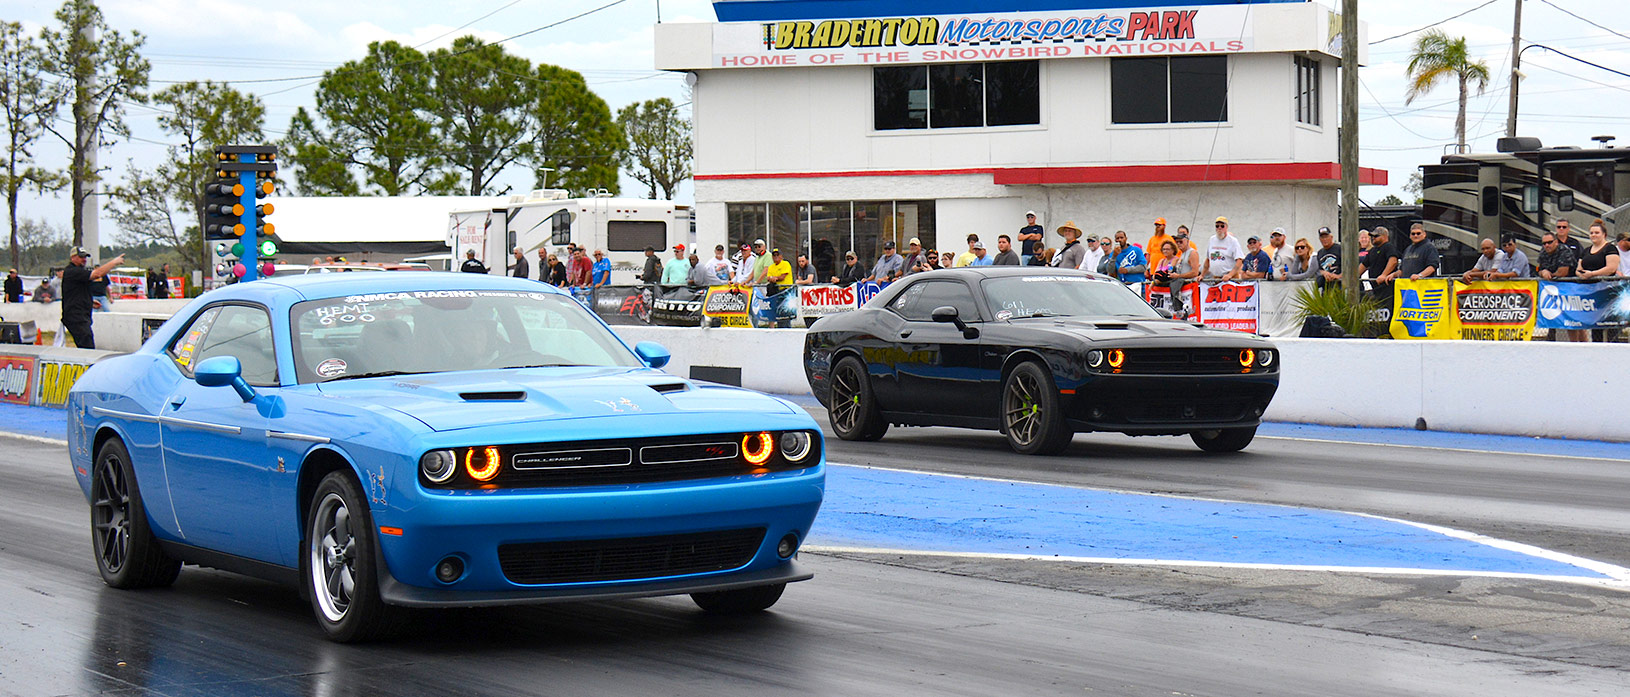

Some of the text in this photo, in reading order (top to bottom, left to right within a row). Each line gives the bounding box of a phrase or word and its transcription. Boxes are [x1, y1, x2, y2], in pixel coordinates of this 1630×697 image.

[775, 10, 1199, 49] BRADENTON Motorsports PARK
[721, 40, 1245, 67] HOME OF THE SNOWBIRD NATIONALS
[357, 292, 411, 302] NMCA
[413, 290, 477, 299] RACING
[711, 292, 743, 304] AEROSPAC
[801, 286, 854, 306] MOTHERS
[1205, 284, 1255, 303] ARP
[707, 303, 745, 311] COMPONENT
[1463, 295, 1521, 308] AEROSPACE
[1561, 295, 1595, 311] Miller
[315, 302, 369, 317] HEMI
[1458, 309, 1527, 320] COMPONENTS
[730, 316, 749, 325] CIRCLE
[1498, 327, 1524, 340] CIRCLE
[516, 456, 582, 464] CHALLENGER
